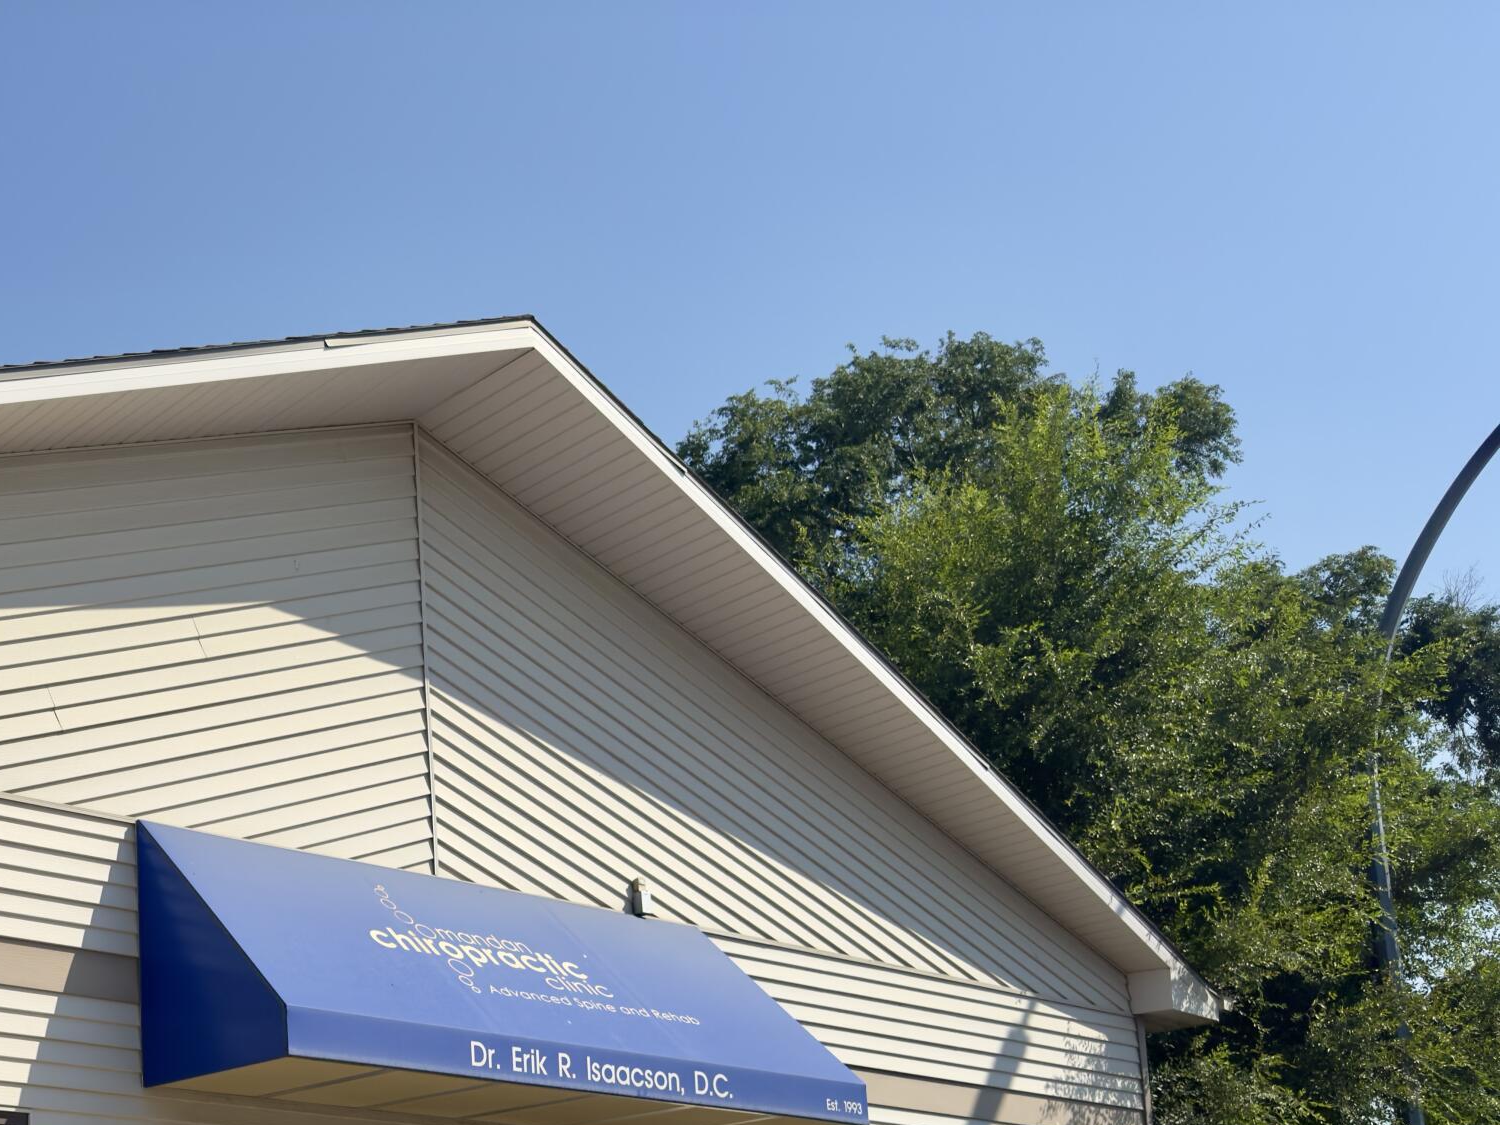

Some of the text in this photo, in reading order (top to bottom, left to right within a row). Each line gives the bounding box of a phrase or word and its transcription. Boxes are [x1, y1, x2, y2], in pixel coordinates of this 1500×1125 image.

[369, 927, 588, 980] chiropractic
[435, 928, 532, 954] mandan
[545, 976, 614, 998] clinic
[489, 985, 701, 1026] Advanced Spine and Rehab
[470, 1041, 734, 1099] Dr. Erik R. Isaacson, D.C.
[826, 1098, 863, 1116] Est. 1993
